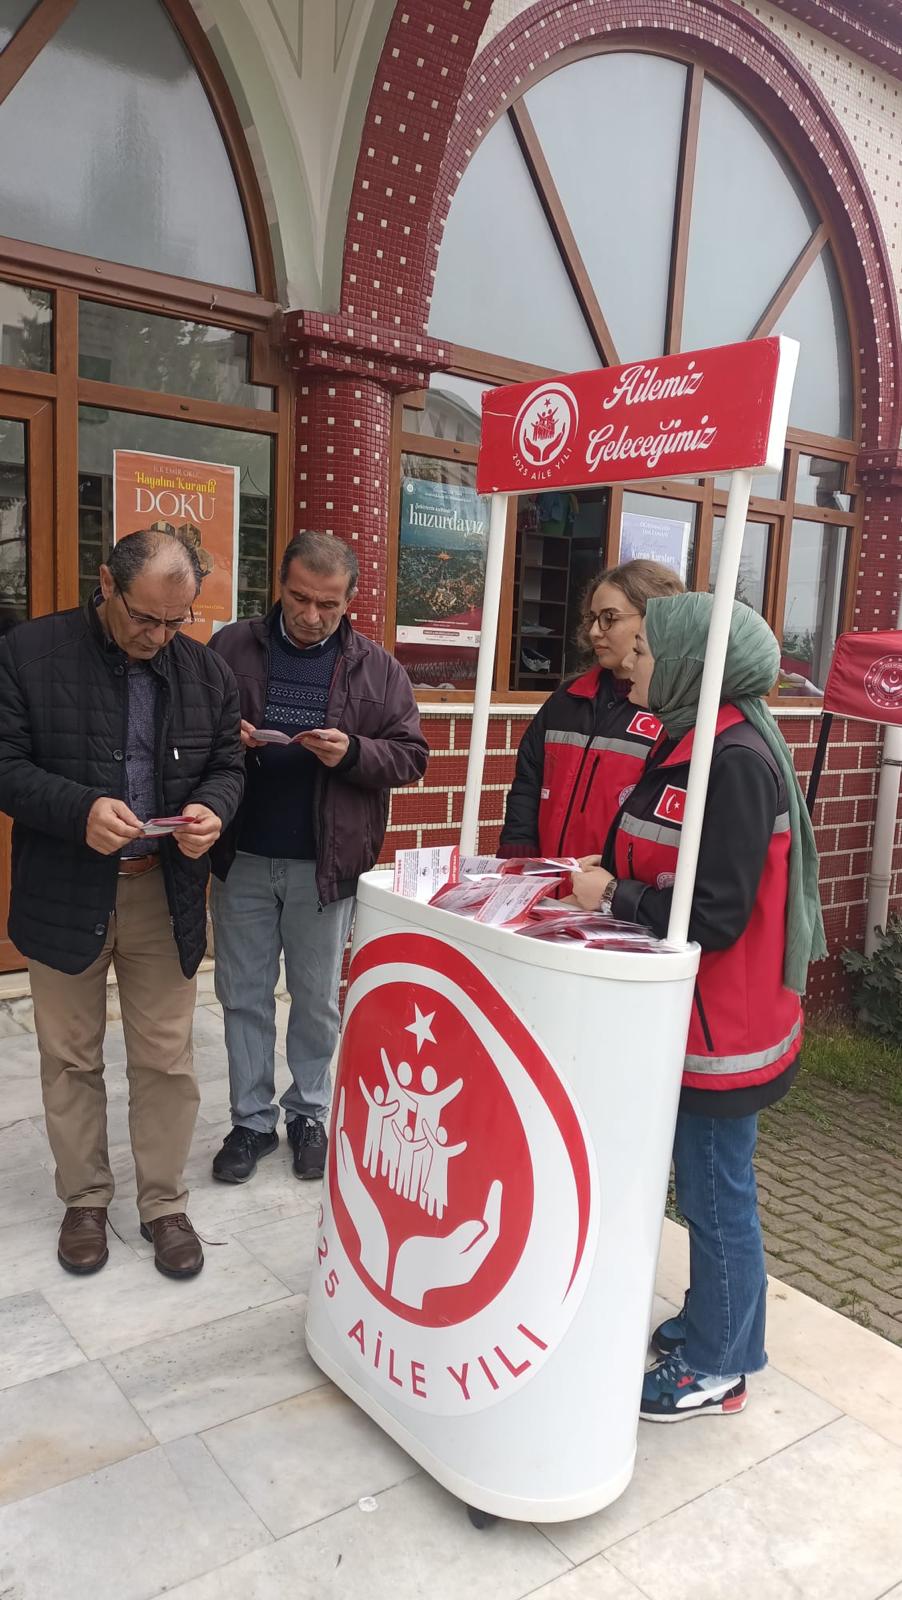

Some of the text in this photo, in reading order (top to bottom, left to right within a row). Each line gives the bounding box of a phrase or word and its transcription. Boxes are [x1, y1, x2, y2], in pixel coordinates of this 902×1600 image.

[602, 360, 705, 410] Ailemiz
[512, 452, 528, 476] 2025
[555, 447, 572, 470] YILI
[585, 414, 717, 473] Geleceğimiz
[135, 487, 217, 524] DOKU
[409, 503, 484, 538] huzurdayız
[347, 1319, 427, 1399] AİLE
[446, 1323, 549, 1400] YILI
